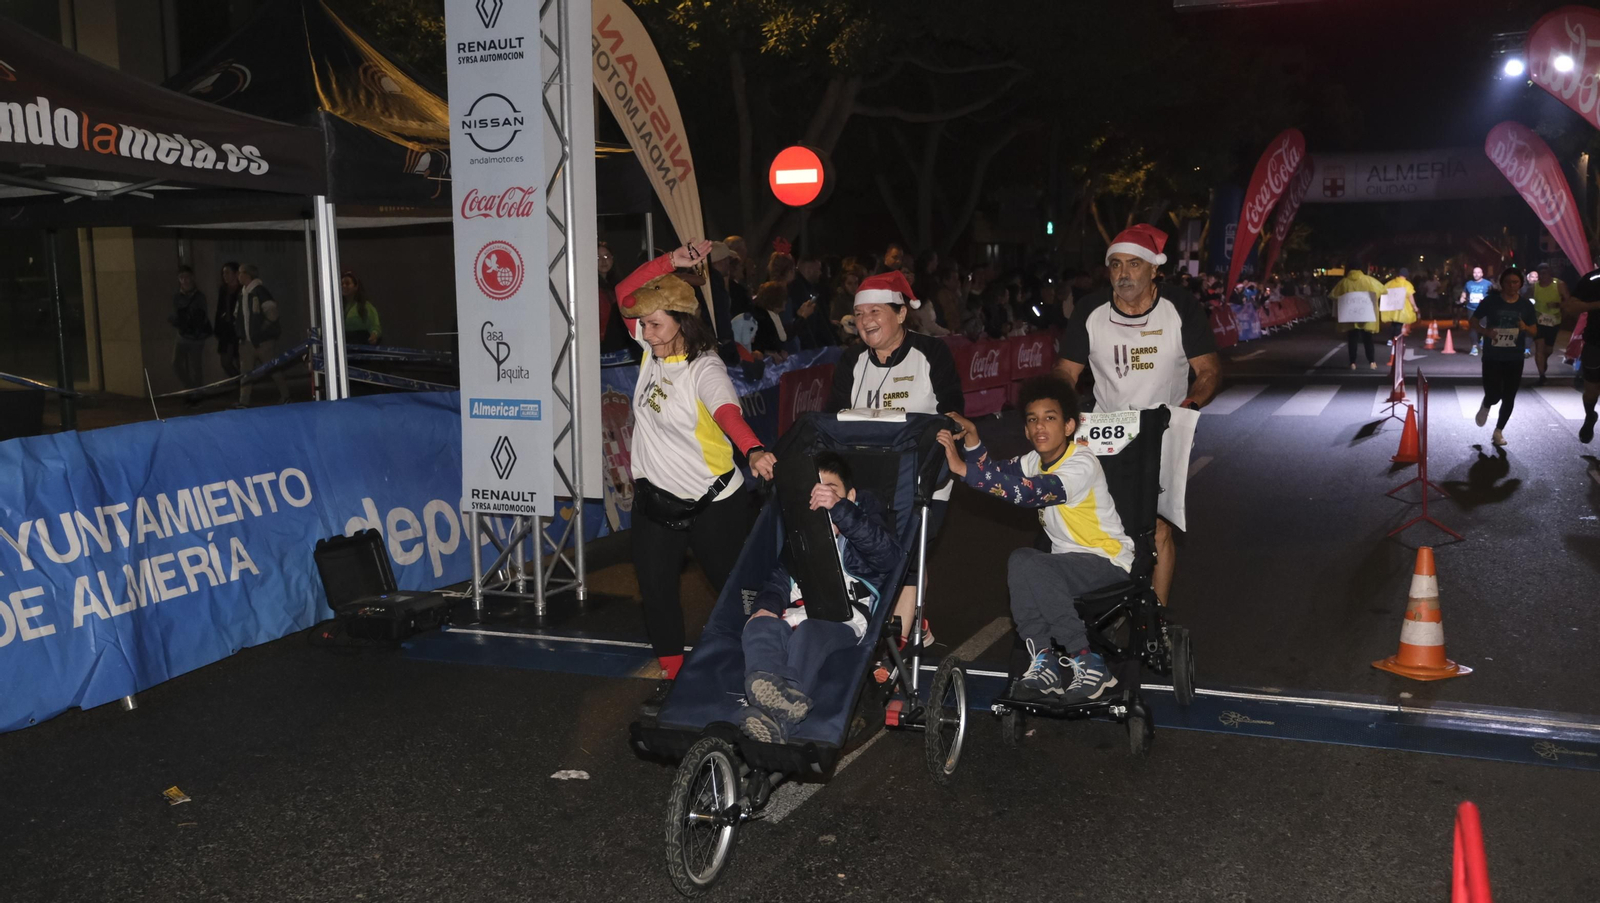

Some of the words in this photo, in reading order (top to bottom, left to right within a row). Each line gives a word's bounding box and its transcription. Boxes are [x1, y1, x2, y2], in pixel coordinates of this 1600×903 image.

[457, 36, 525, 54] RENAULT
[458, 55, 478, 65] SYRSA
[479, 51, 524, 63] AUTOMOCION
[461, 116, 524, 130] NISSAN
[469, 156, 524, 165] andalmotor.es
[1246, 134, 1300, 234] Coca-Cola
[1365, 182, 1418, 197] CIUDAD
[460, 186, 538, 220] Coca-Cola
[1130, 346, 1158, 355] CARROS
[1131, 355, 1140, 363] DE
[1131, 362, 1155, 371] FUEGO
[882, 391, 909, 400] CARROS
[472, 402, 520, 417] Almericar
[883, 400, 892, 408] DE
[1089, 425, 1125, 440] 668
[471, 488, 537, 503] RENAULT
[471, 502, 491, 510] SYRSA
[493, 504, 536, 513] AUTOMOCION
[0, 467, 313, 577] YUNTAMIENTO
[73, 532, 260, 629] ALMERÍA
